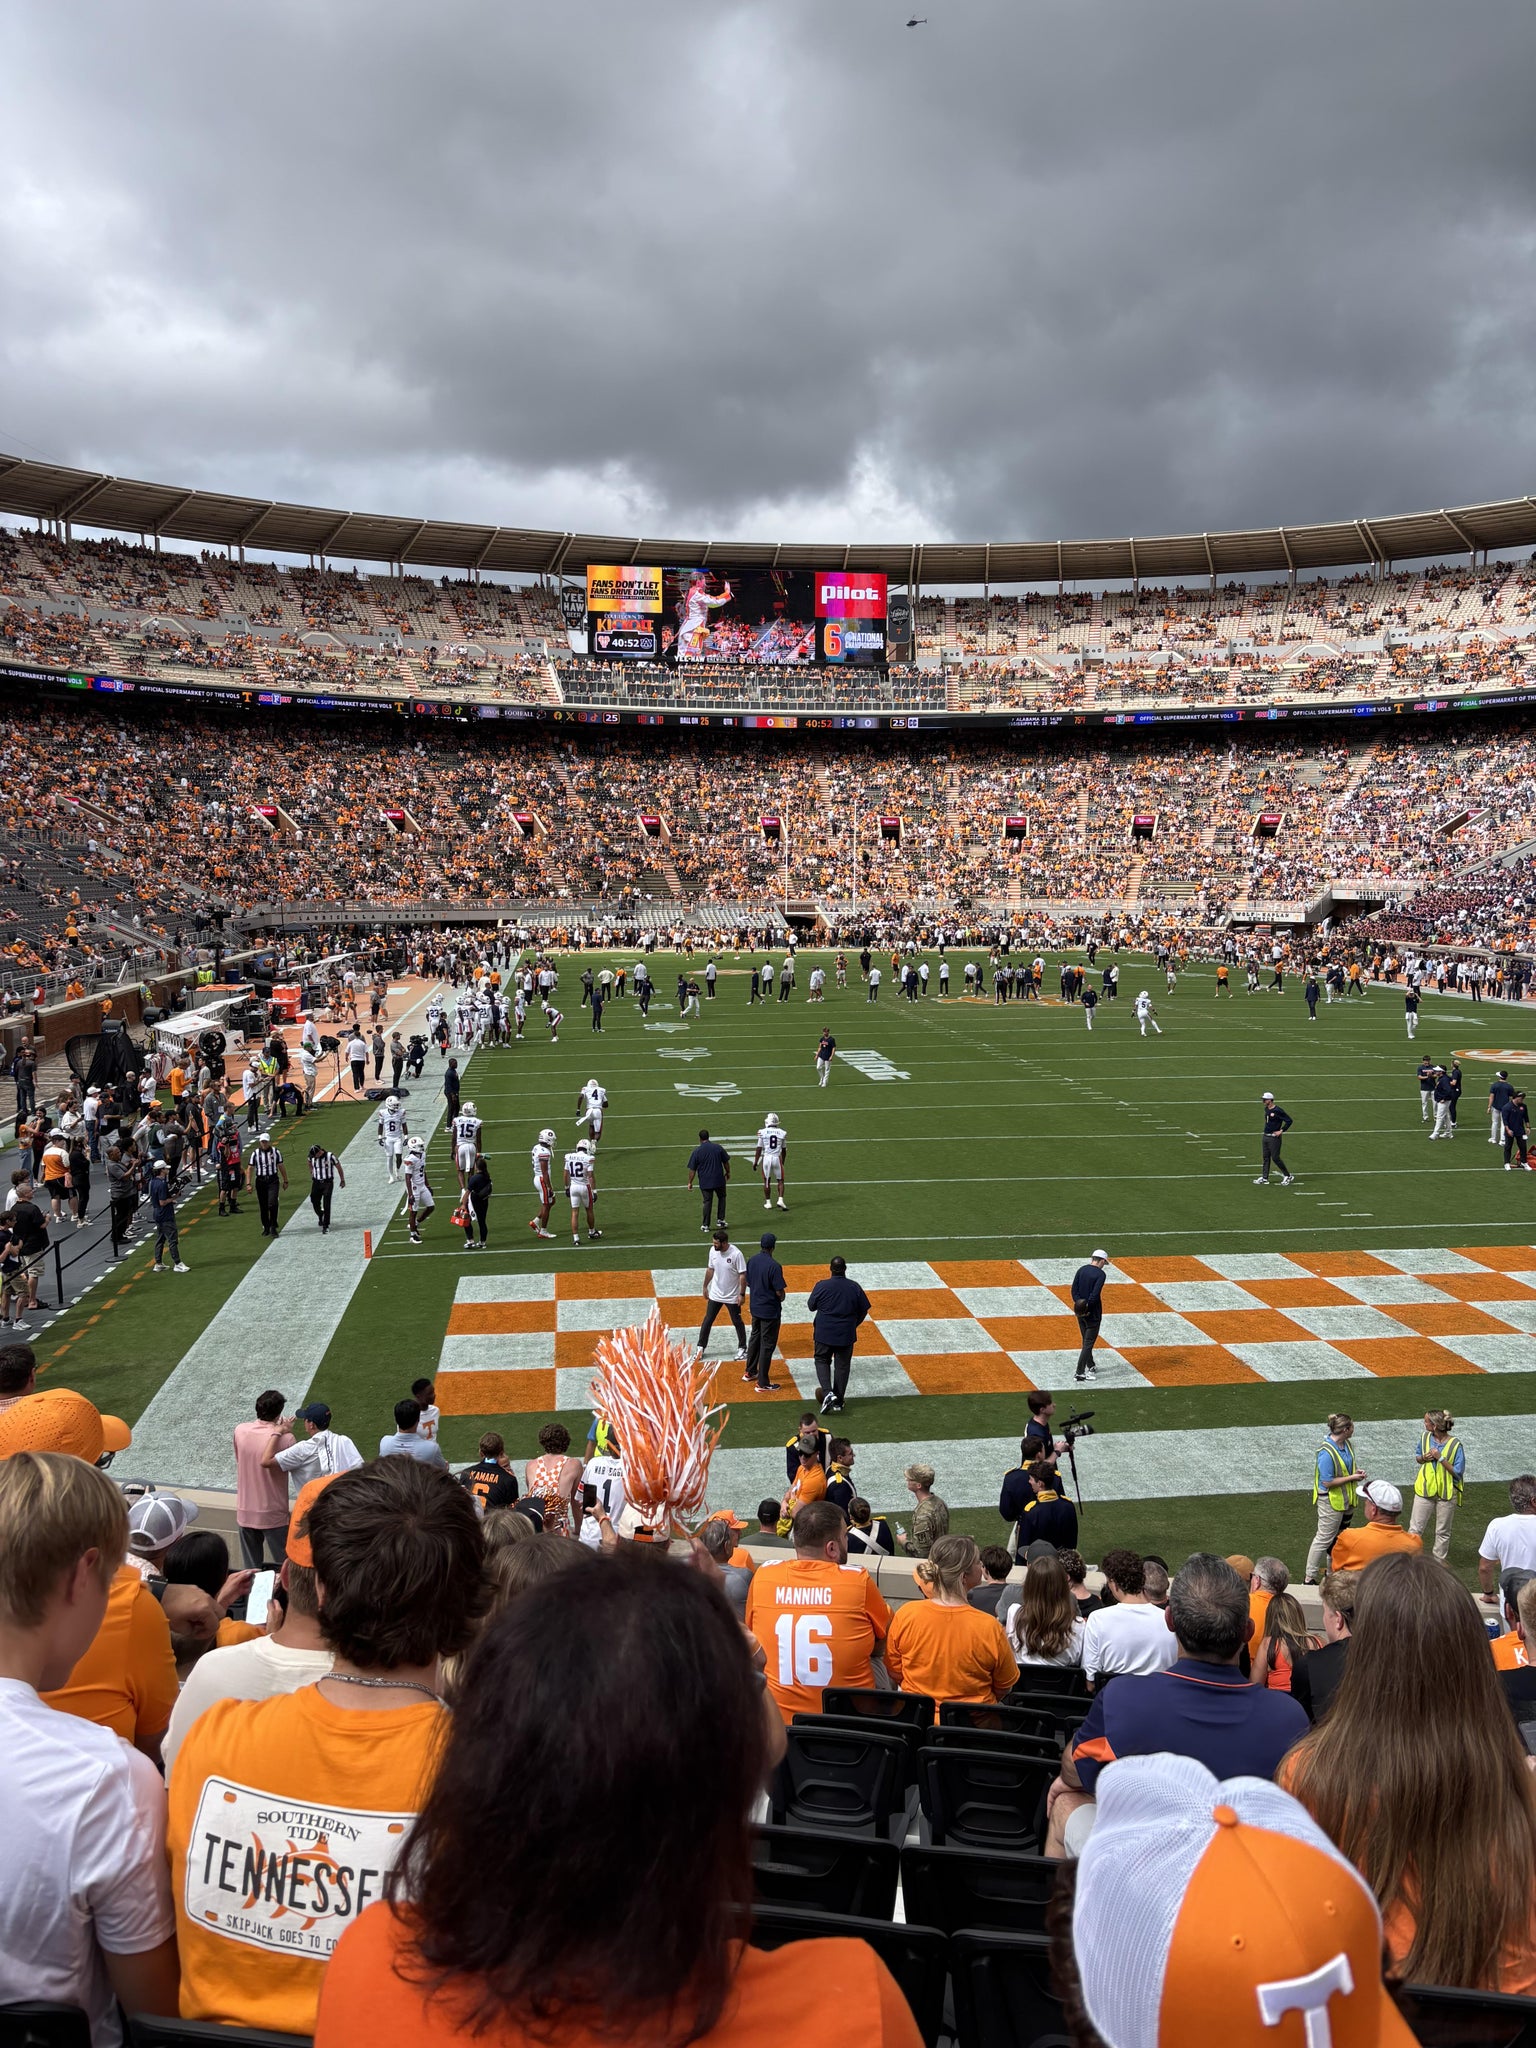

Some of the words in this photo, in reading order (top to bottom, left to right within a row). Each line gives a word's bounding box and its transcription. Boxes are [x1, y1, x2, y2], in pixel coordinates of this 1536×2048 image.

[592, 580, 614, 588] FANS
[615, 580, 642, 588] DON'T
[564, 593, 584, 602] YEE
[564, 602, 584, 612] HAW
[824, 624, 842, 656] 6
[853, 632, 884, 643] NATIONAL
[612, 638, 640, 648] 40:52
[8, 670, 46, 680] SUPERMARKET
[140, 685, 164, 693] OFFICIAL
[165, 687, 204, 696] SUPERMARKET
[242, 692, 252, 702] T
[1479, 696, 1518, 705] SUPERMARKET
[394, 702, 404, 712] T
[1394, 704, 1404, 714] T
[605, 714, 618, 722] 25
[656, 716, 664, 724] 10
[1236, 711, 1246, 720] T
[692, 716, 698, 724] ON
[700, 717, 710, 726] 25
[766, 718, 774, 726] 0
[805, 719, 832, 728] 40:52
[864, 720, 872, 728] 0
[1142, 1000, 1146, 1008] 5
[430, 1010, 439, 1018] 23
[591, 1088, 599, 1101] 4
[389, 1121, 396, 1132] 6
[460, 1123, 474, 1138] 15
[770, 1134, 778, 1150] 8
[569, 1161, 584, 1178] 12
[422, 1418, 436, 1440] T
[594, 1466, 606, 1475] WAR
[470, 1470, 499, 1484] KAMARA
[472, 1482, 490, 1508] 6
[602, 1478, 613, 1514] 1
[776, 1586, 832, 1606] MANNING
[774, 1614, 834, 1687] 16
[257, 1811, 362, 1842] SOUTHERN
[287, 1825, 330, 1846] TIDE
[226, 1914, 274, 1940] SKIPJACK
[279, 1928, 304, 1946] GOES
[310, 1934, 320, 1948] TO
[326, 1936, 339, 1951] CO
[1256, 1952, 1354, 2048] T
